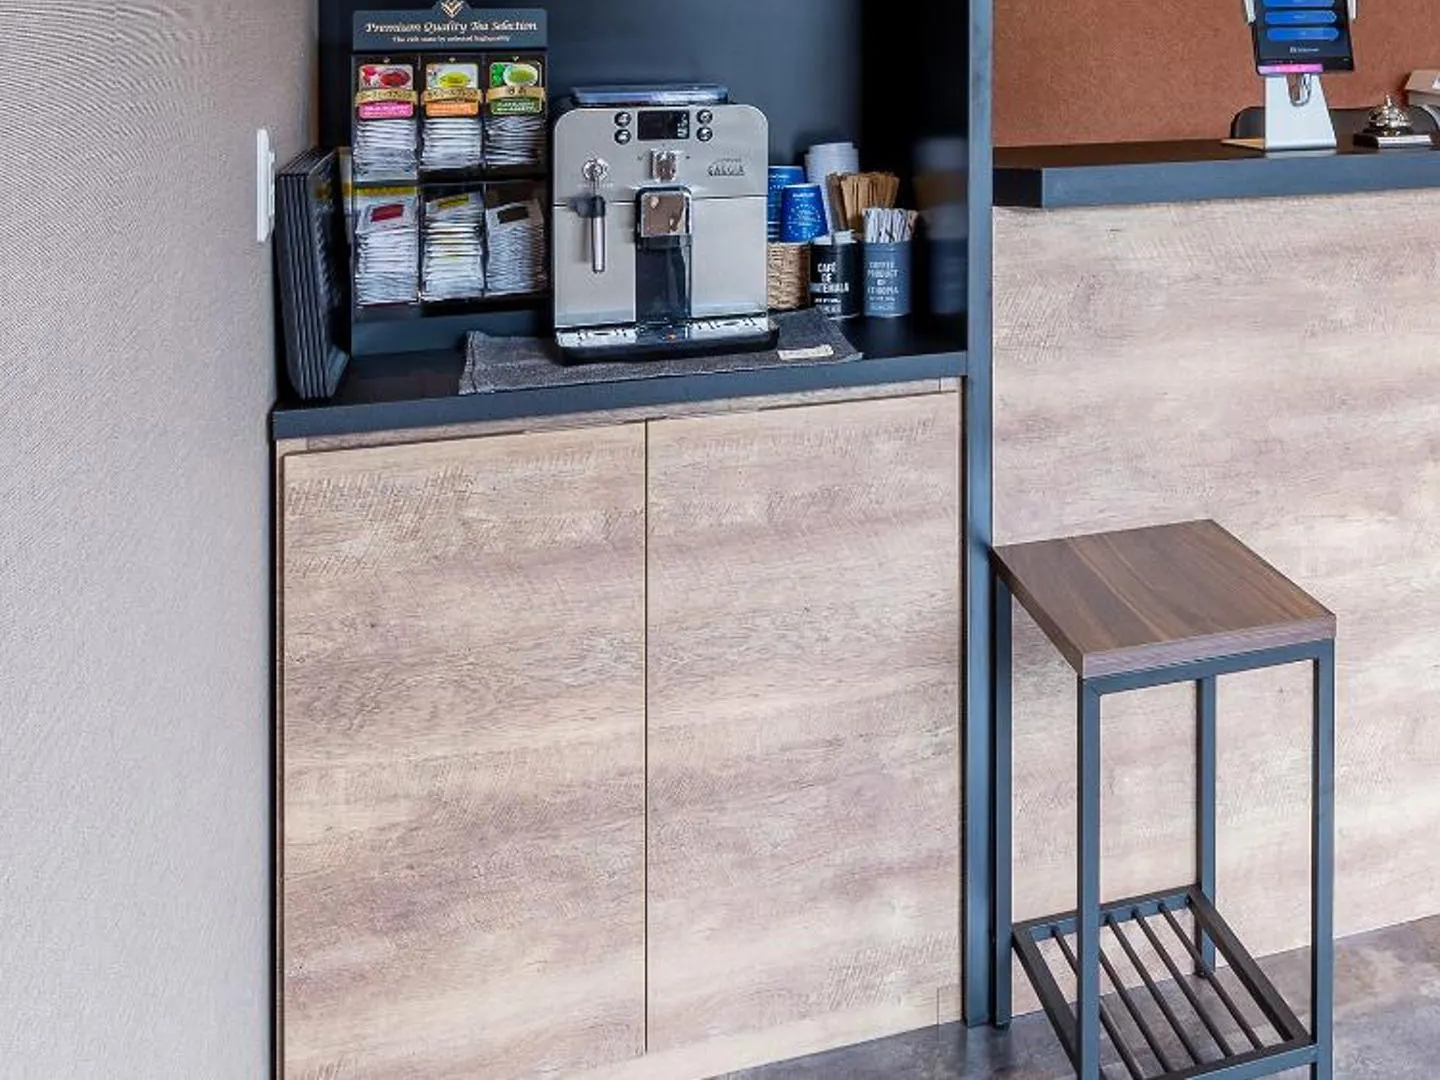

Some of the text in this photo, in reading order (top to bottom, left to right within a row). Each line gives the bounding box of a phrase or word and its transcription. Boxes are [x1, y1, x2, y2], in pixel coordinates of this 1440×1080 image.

[365, 20, 538, 34] Premium Quality Tea Selection
